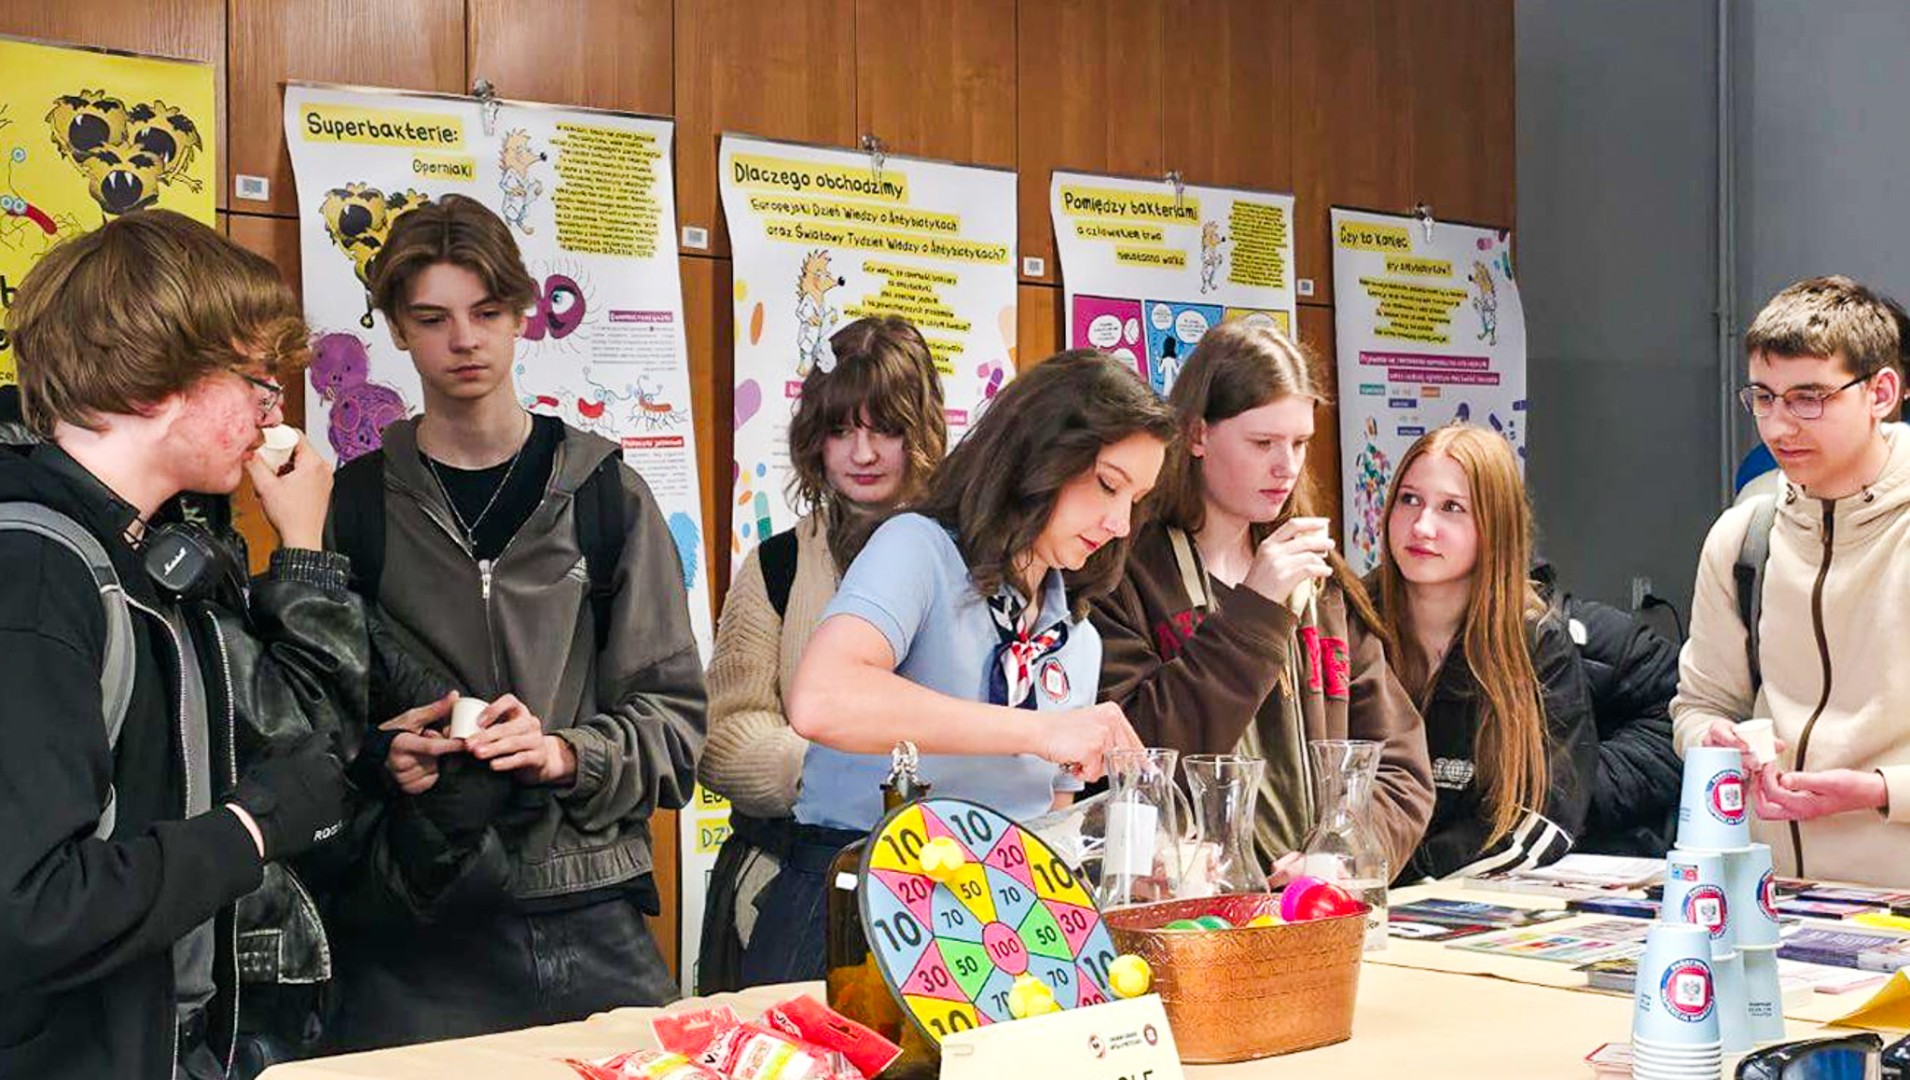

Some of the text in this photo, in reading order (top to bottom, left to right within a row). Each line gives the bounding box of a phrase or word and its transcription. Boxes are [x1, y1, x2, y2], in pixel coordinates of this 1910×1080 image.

[306, 112, 459, 143] Superbakterie:
[412, 158, 473, 178] Oporniaki
[734, 162, 904, 199] Dlaczego obchodzimy
[750, 198, 958, 231] Europejski Dzień Wiedzy o Antybiotykach
[1063, 191, 1198, 221] Pomiędzy bakteriami
[766, 224, 793, 238] oraz
[794, 224, 845, 244] Światowy
[885, 236, 920, 253] Wiedzy
[1340, 225, 1358, 247] Czy
[1360, 231, 1373, 246] to
[949, 810, 993, 846] 10
[881, 828, 925, 866] 10
[996, 844, 1026, 869] 20
[1032, 858, 1075, 894] 10
[897, 878, 928, 905] 20
[959, 880, 983, 900] 50
[999, 886, 1022, 907] 70
[873, 911, 923, 953] 10
[940, 909, 965, 930] 70
[1060, 909, 1088, 935] 30
[990, 937, 1021, 960] 100
[1035, 925, 1058, 946] 50
[917, 965, 949, 993] 30
[954, 955, 979, 978] 50
[1046, 967, 1070, 988] 70
